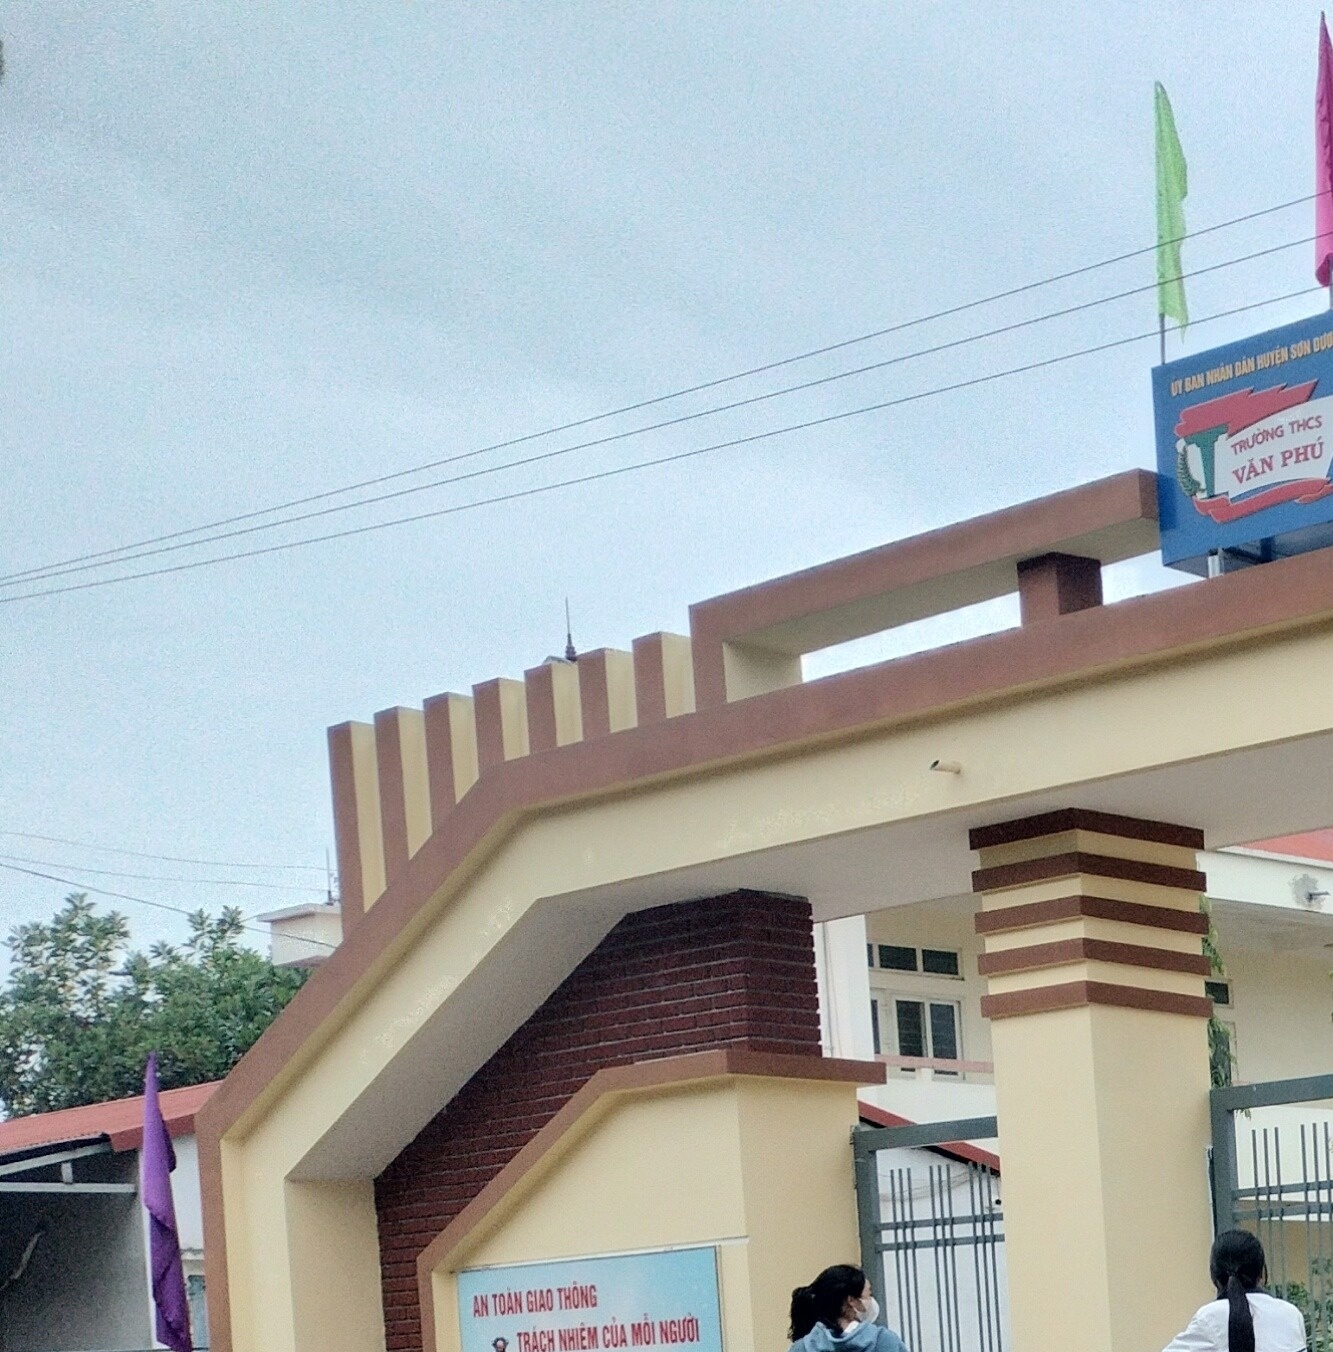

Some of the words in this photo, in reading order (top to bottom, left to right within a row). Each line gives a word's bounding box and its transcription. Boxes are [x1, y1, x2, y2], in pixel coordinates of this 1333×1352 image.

[1184, 372, 1206, 393] BAN
[1230, 424, 1285, 455] TRƯỜNG
[1288, 415, 1323, 434] THCS
[1232, 455, 1274, 484] VĂN
[1280, 435, 1325, 468] PHÚ
[473, 1294, 490, 1318] AN
[491, 1286, 523, 1316] TOÀN
[526, 1289, 554, 1313] GIAO
[556, 1281, 598, 1310] THÔNG
[602, 1316, 628, 1349] CỦA
[631, 1312, 656, 1346] MỖI
[658, 1312, 701, 1345] NGƯỜI
